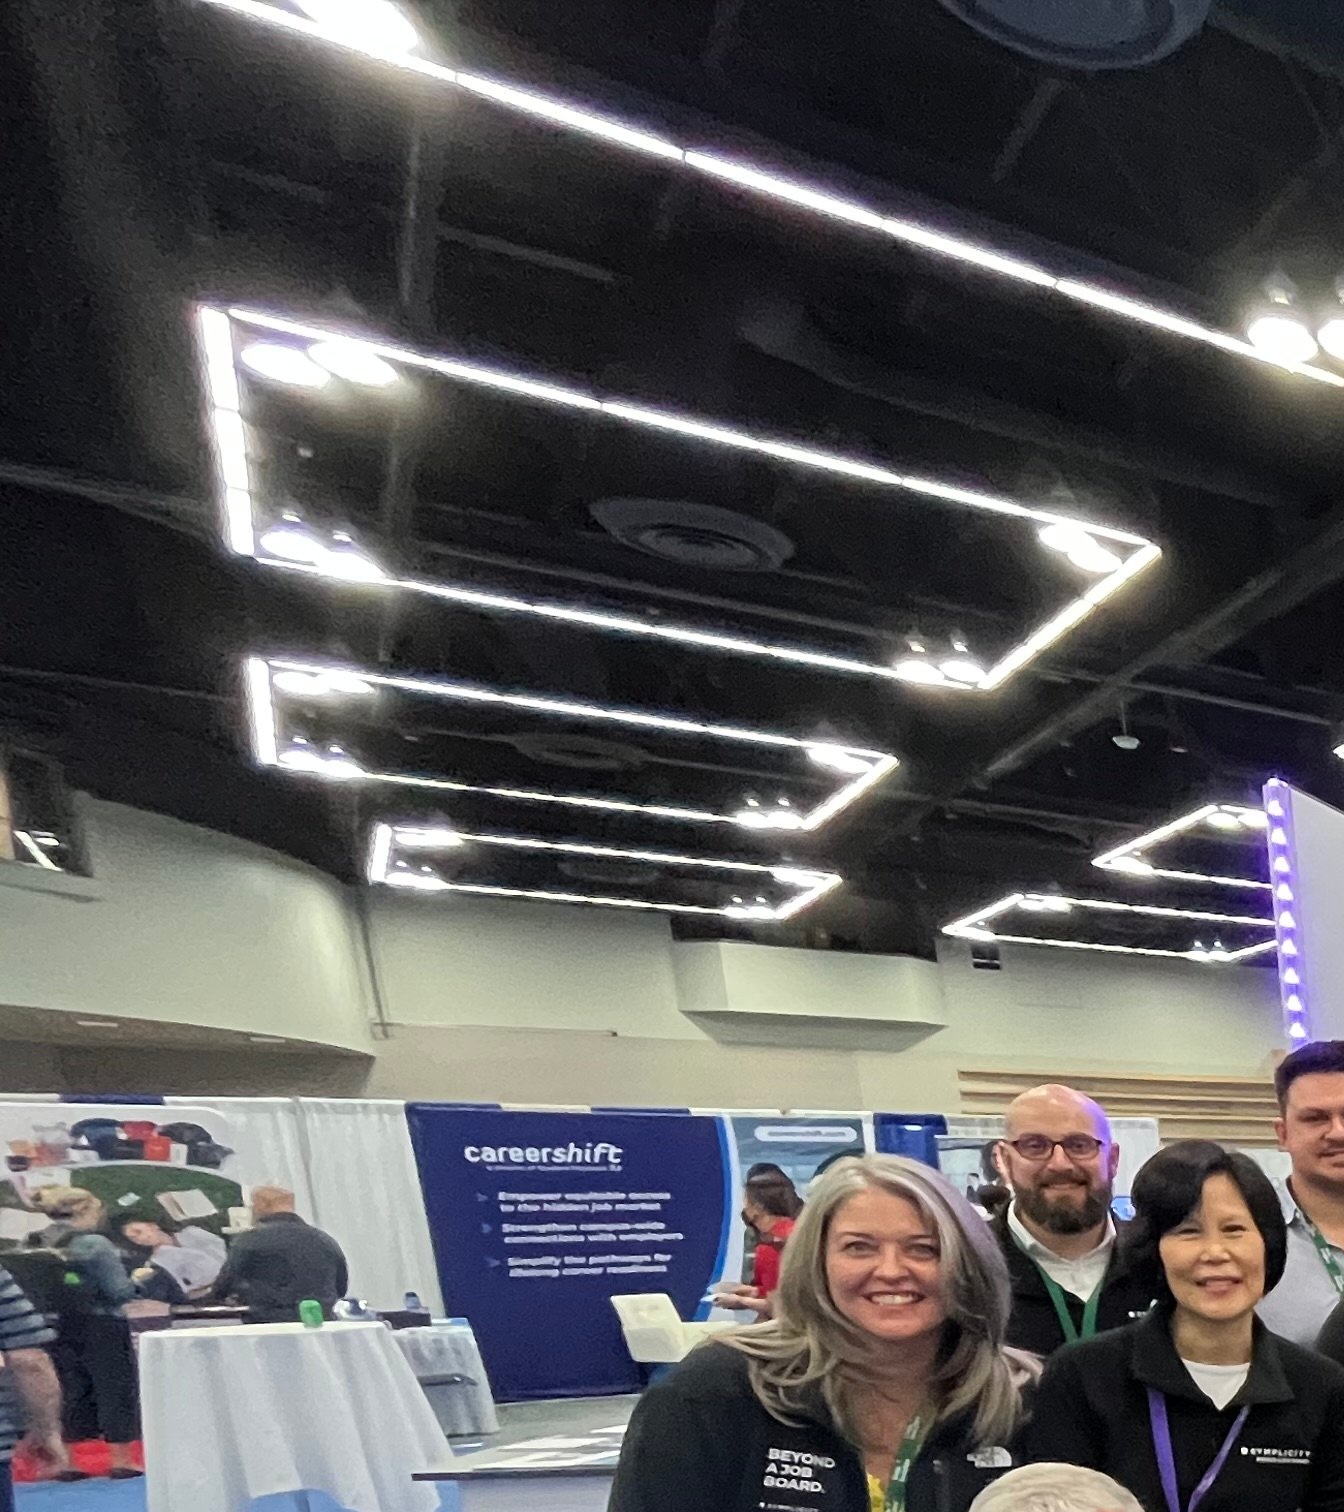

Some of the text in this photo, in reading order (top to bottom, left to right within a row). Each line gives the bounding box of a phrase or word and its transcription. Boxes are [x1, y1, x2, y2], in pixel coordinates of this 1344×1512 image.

[463, 1142, 623, 1164] careershift
[767, 1448, 836, 1469] BEYOND
[765, 1462, 813, 1478] A JOB
